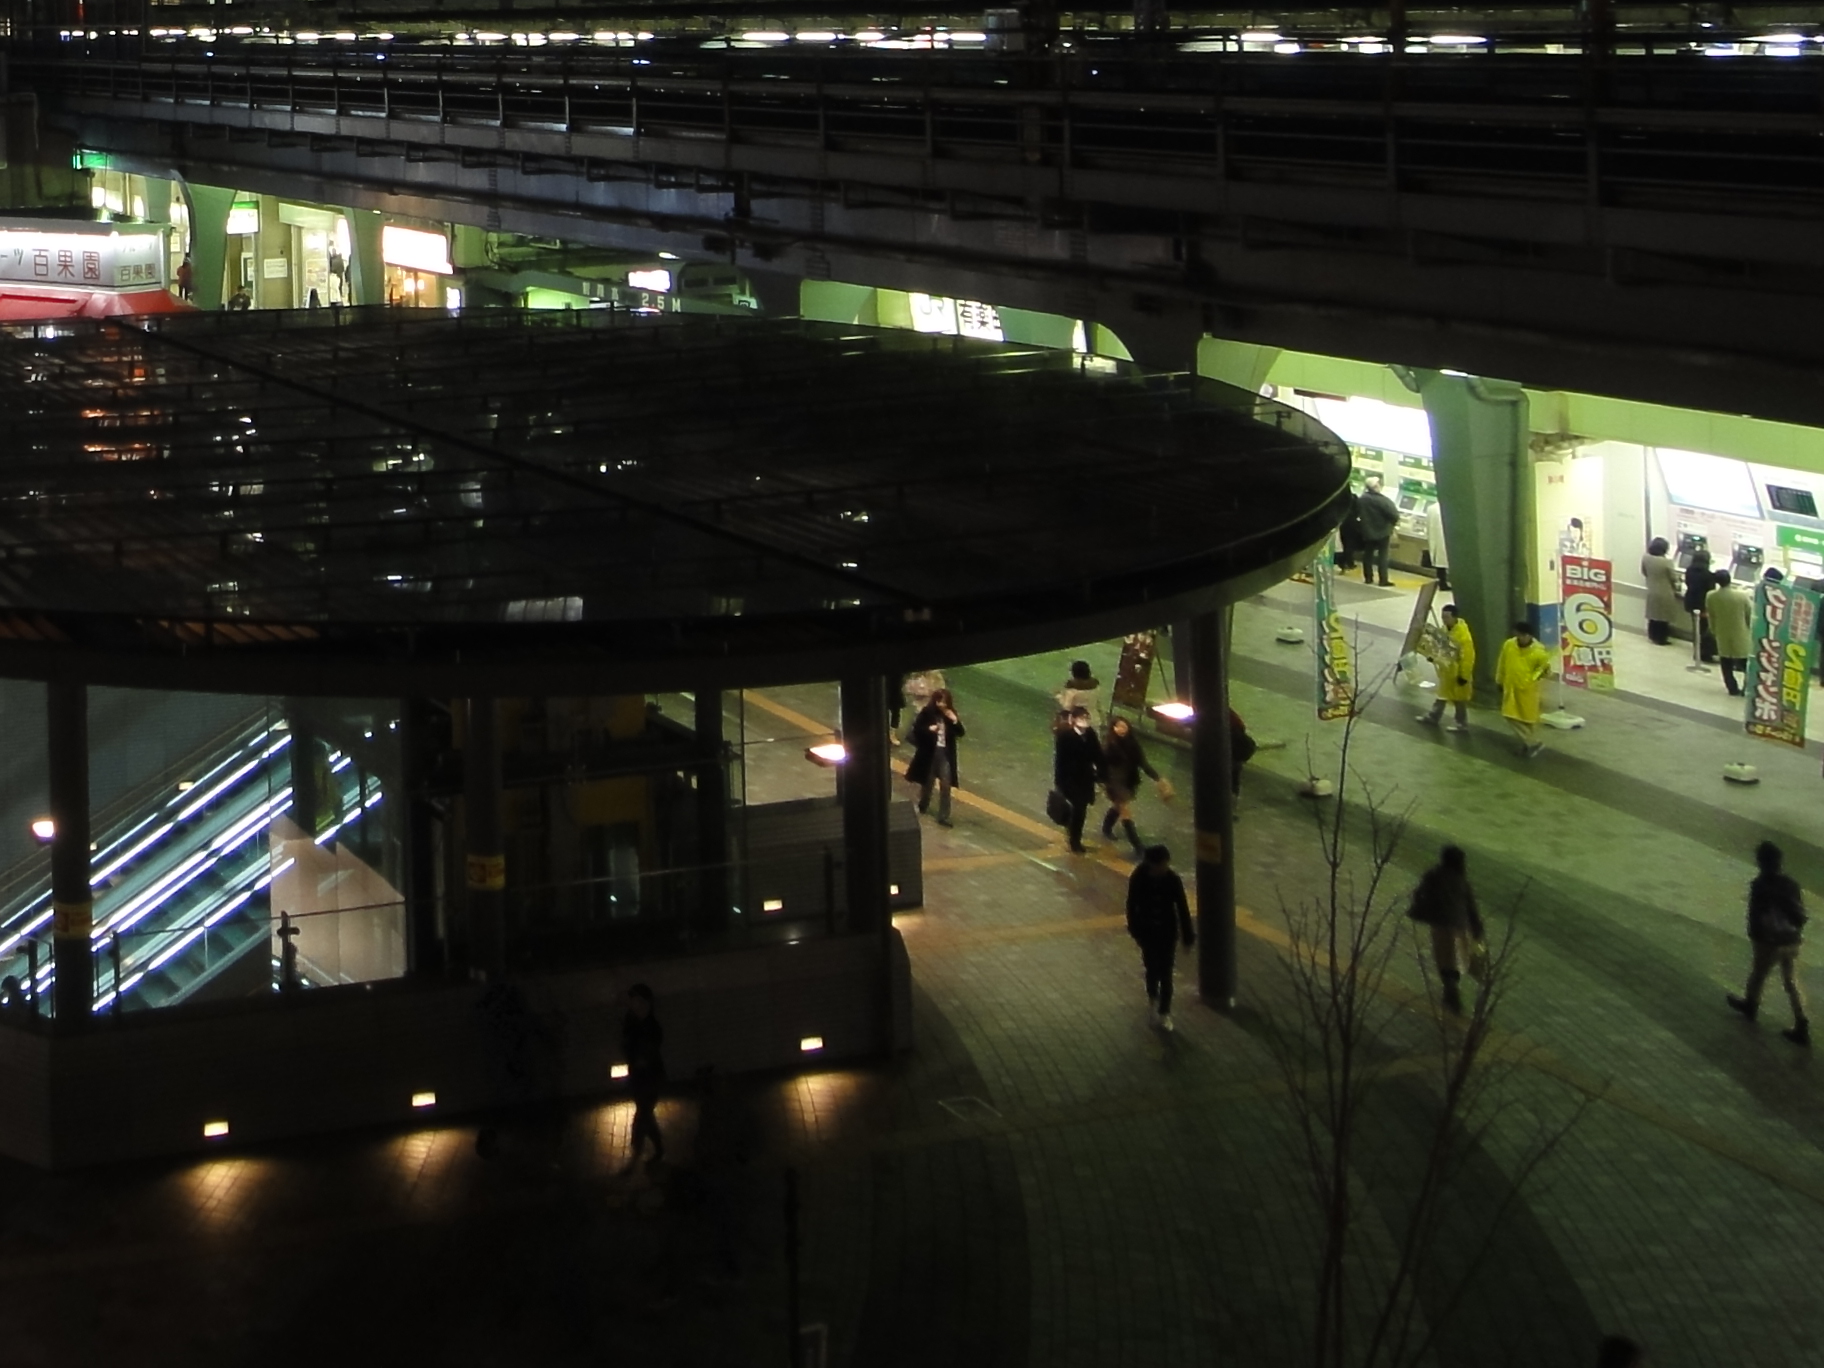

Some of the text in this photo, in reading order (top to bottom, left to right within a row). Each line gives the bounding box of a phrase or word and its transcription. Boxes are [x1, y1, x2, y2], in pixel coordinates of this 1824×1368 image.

[31, 248, 101, 281] 百果園
[1753, 584, 1787, 721] グリーンジャンボ
